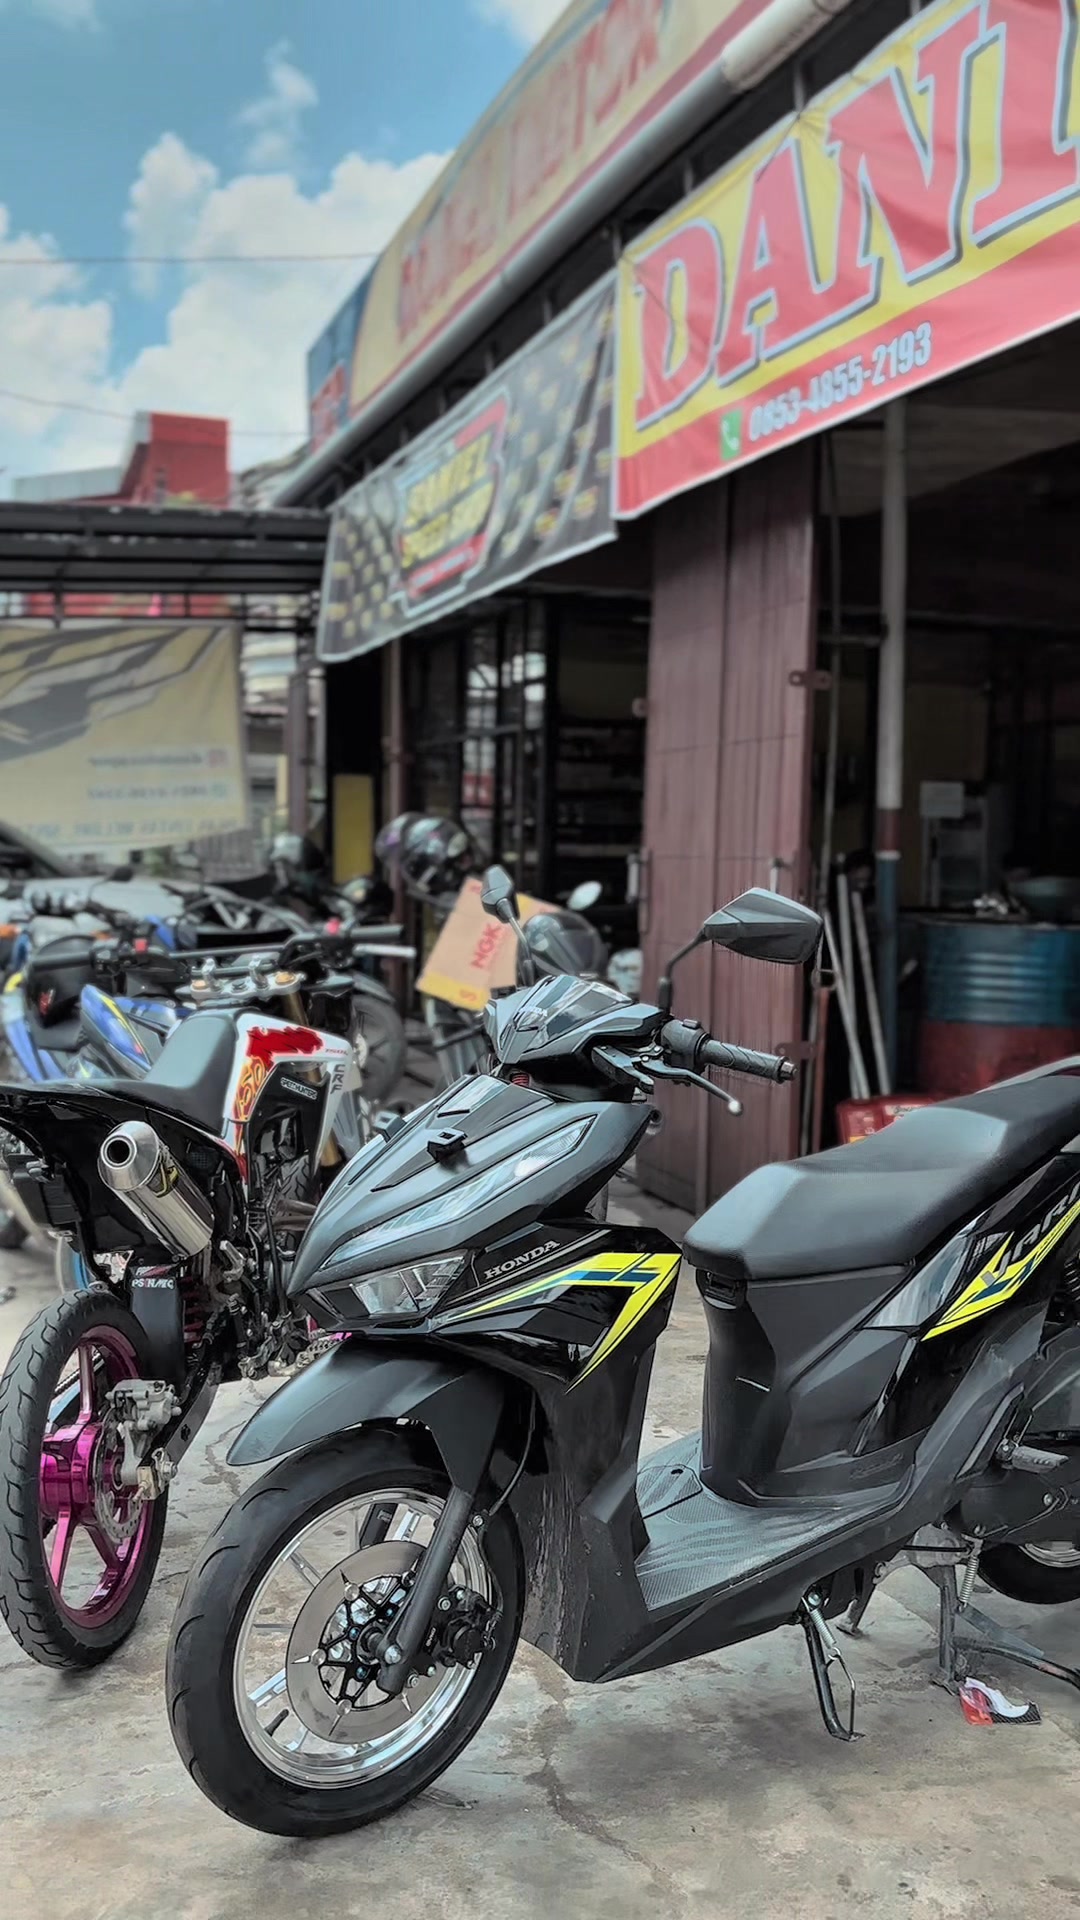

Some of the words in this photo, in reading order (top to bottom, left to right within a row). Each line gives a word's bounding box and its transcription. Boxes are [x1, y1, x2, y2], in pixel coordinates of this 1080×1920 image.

[470, 921, 502, 970] NGK
[330, 1064, 346, 1094] CRF
[483, 1240, 561, 1280] HONDA
